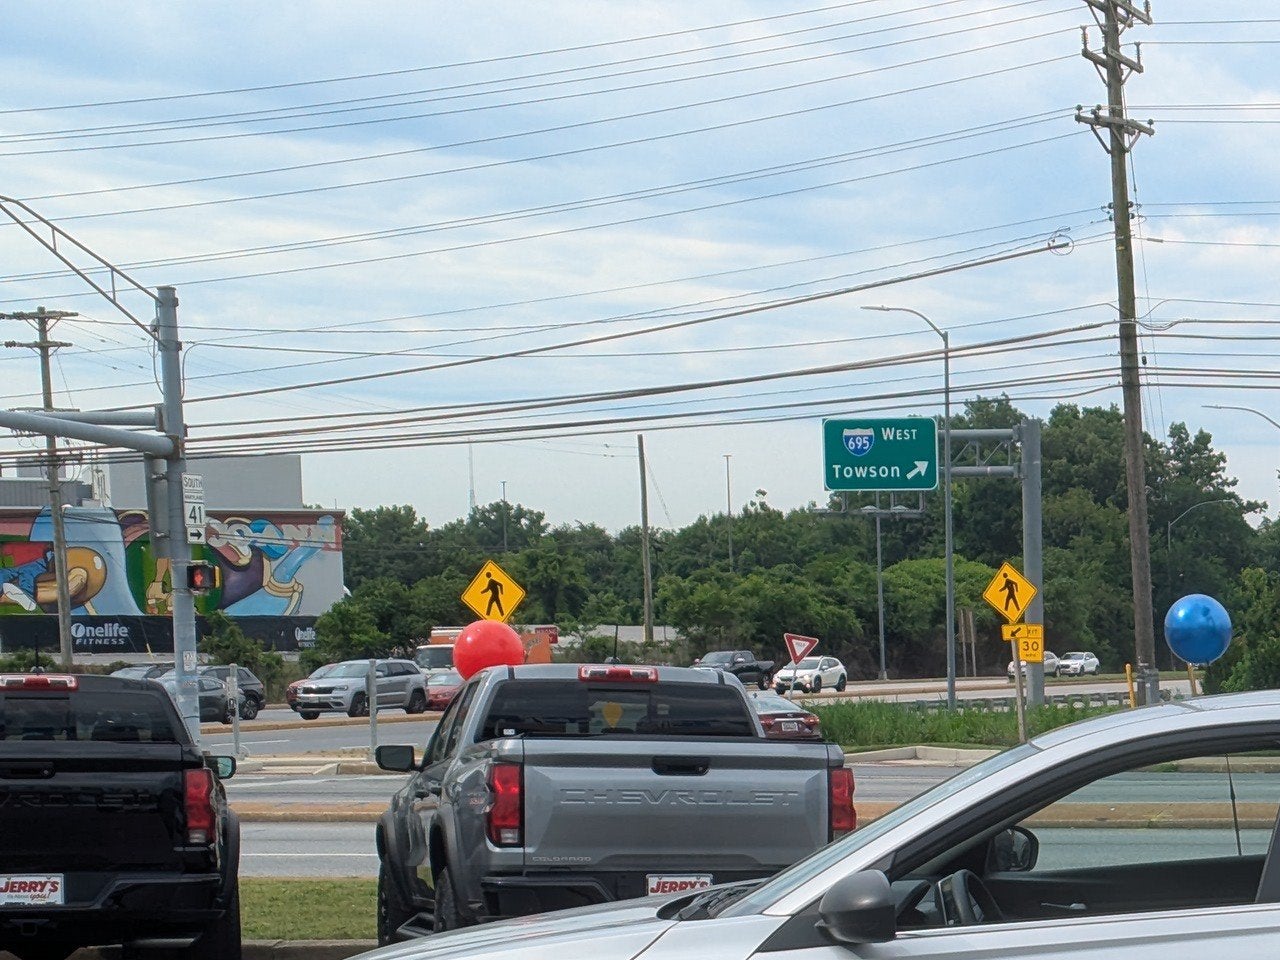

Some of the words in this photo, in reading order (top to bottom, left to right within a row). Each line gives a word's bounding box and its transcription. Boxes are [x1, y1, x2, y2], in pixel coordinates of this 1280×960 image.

[848, 436, 870, 450] 695
[832, 464, 901, 479] Towson
[183, 476, 203, 488] SOUTH
[189, 505, 202, 524] 41
[71, 622, 129, 638] Onelife
[1022, 641, 1039, 652] 30
[560, 788, 800, 806] CHEVROLET
[0, 880, 60, 893] JERRY'S
